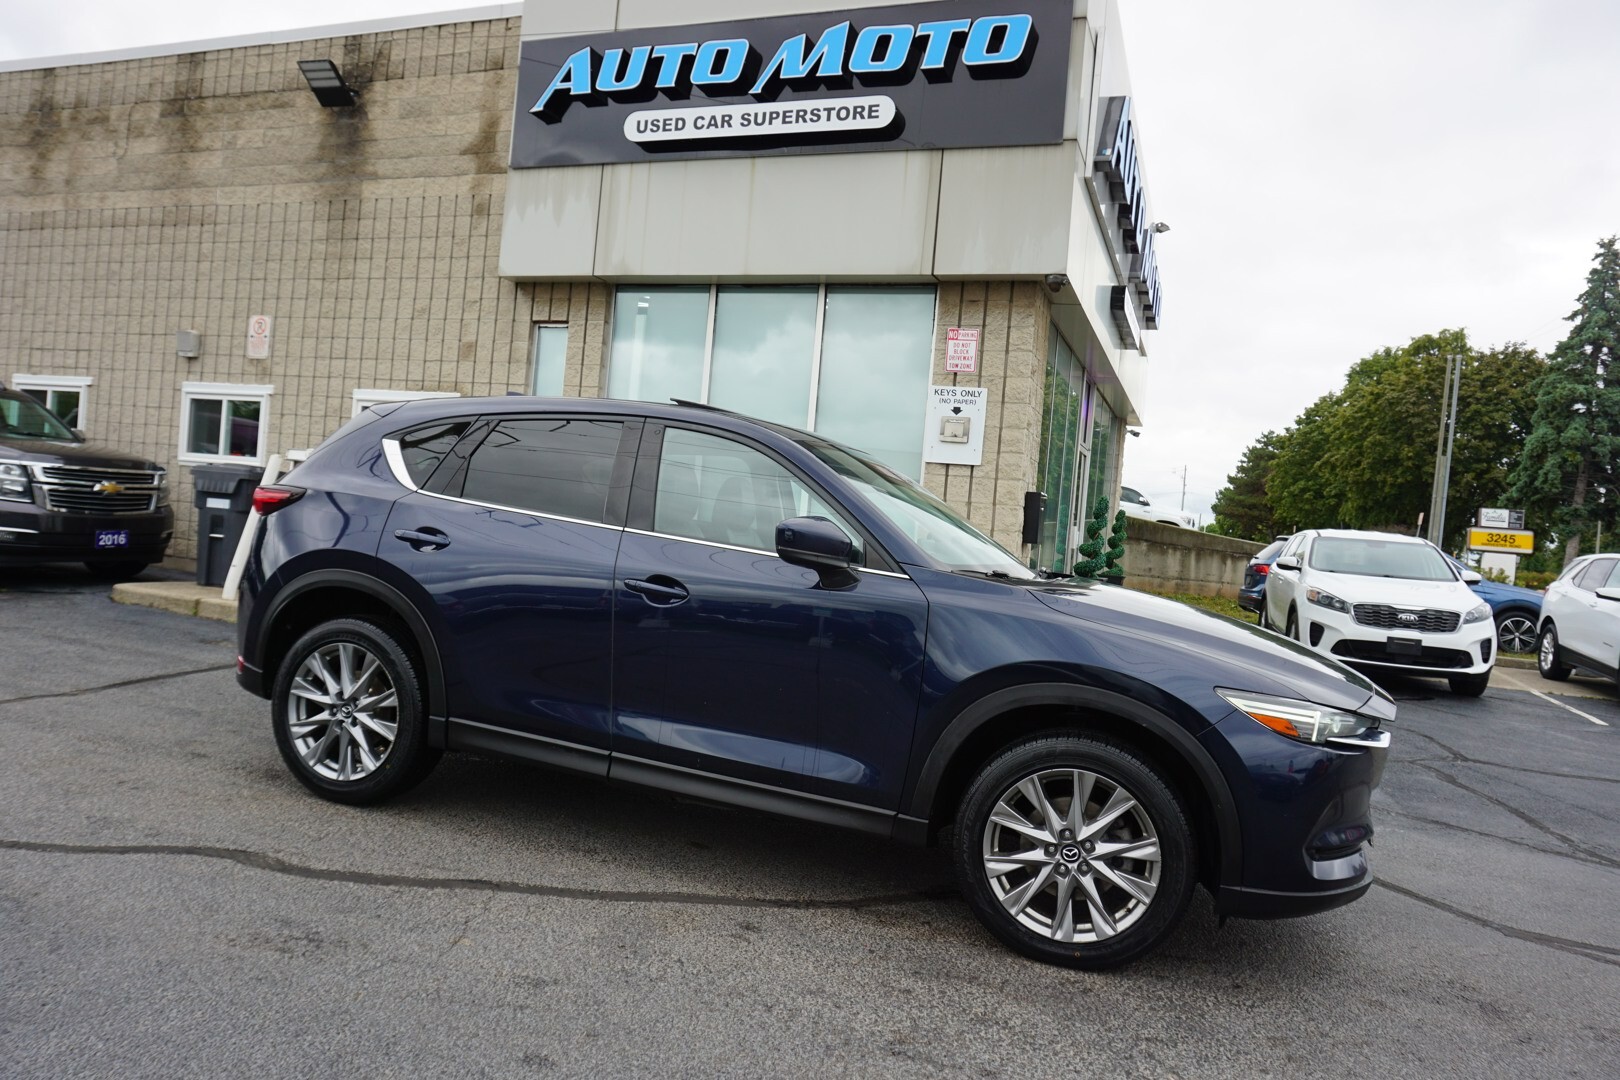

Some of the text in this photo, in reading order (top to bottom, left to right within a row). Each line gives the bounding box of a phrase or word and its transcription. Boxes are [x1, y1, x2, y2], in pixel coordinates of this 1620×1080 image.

[529, 14, 1033, 113] AUTO MOTO
[636, 103, 880, 134] USED CAR SUPERSTORE
[949, 330, 958, 339] NO
[934, 388, 983, 398] KEYS ONLY
[953, 398, 977, 406] PAPER)
[98, 534, 127, 545] 2016
[1486, 533, 1516, 544] 3245
